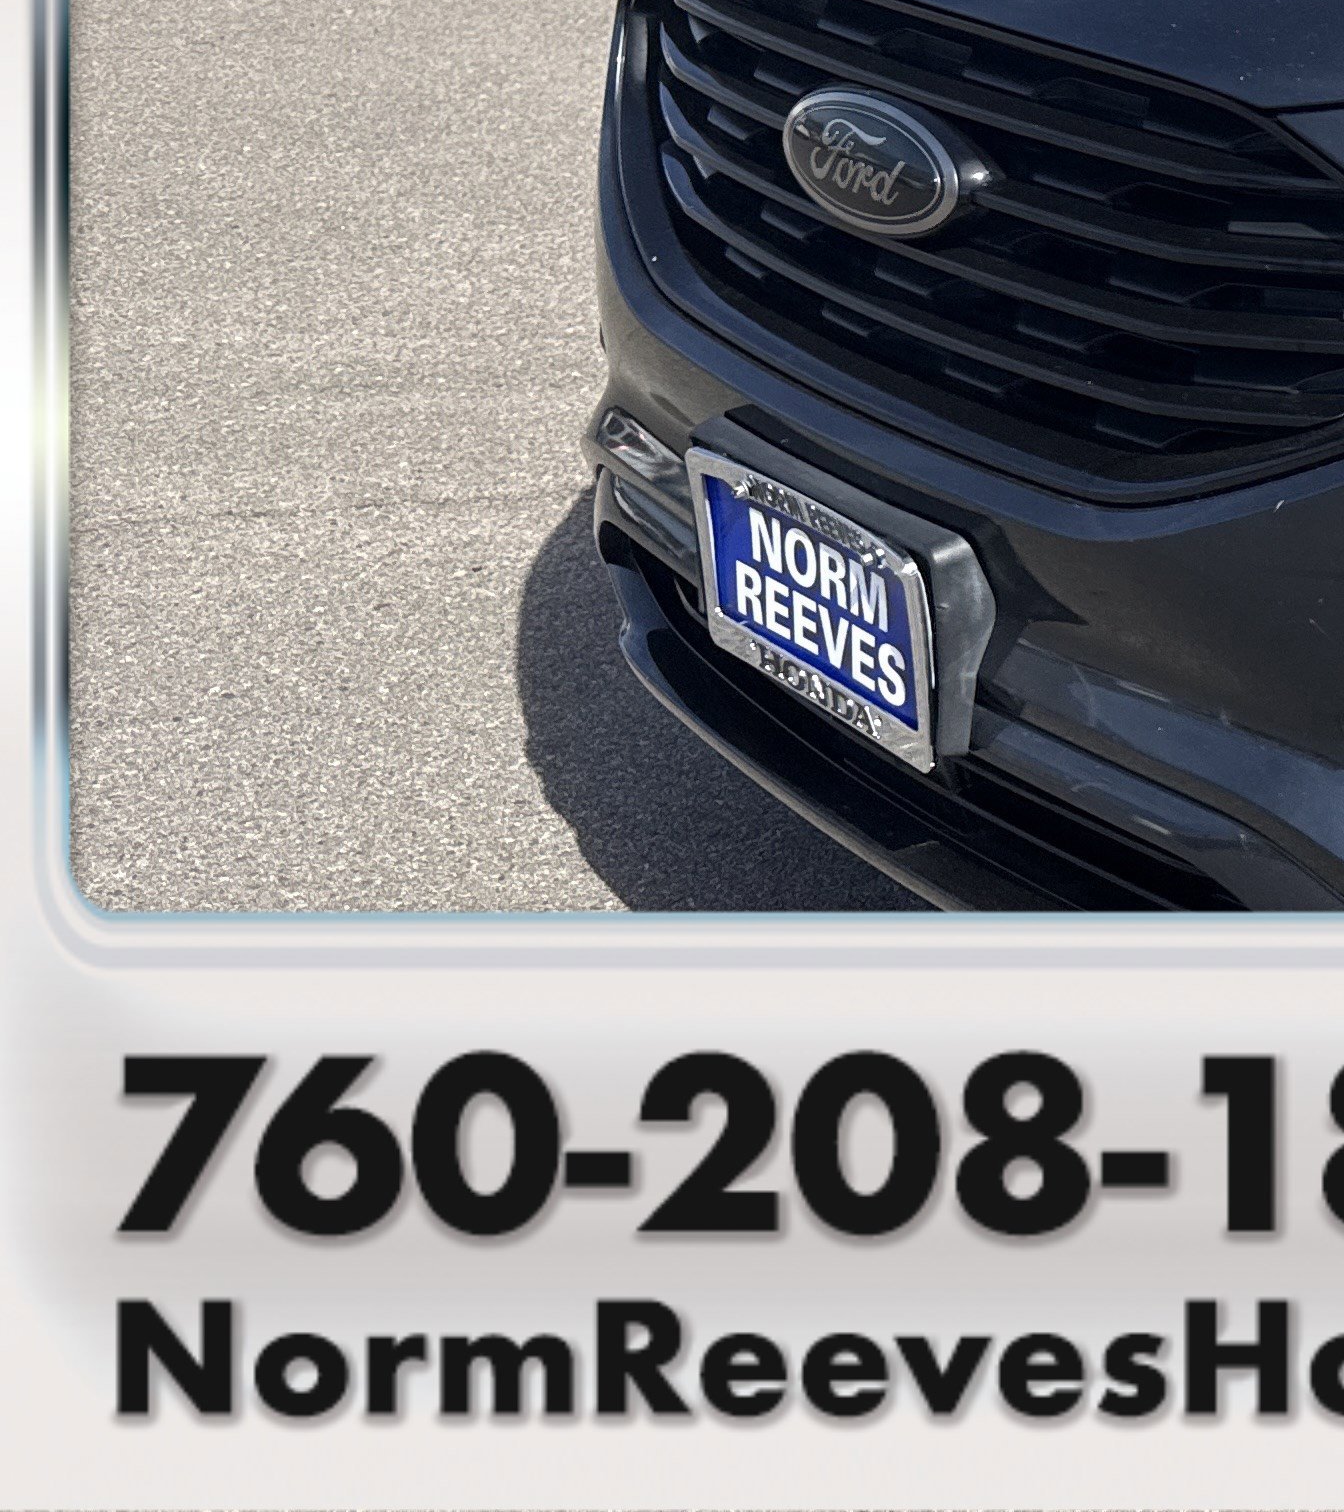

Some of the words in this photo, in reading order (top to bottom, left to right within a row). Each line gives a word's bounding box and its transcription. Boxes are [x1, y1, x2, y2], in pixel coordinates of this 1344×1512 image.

[811, 118, 905, 205] Ford
[748, 506, 889, 632] NORM
[735, 560, 905, 707] REEVES
[758, 642, 881, 740] HONDA
